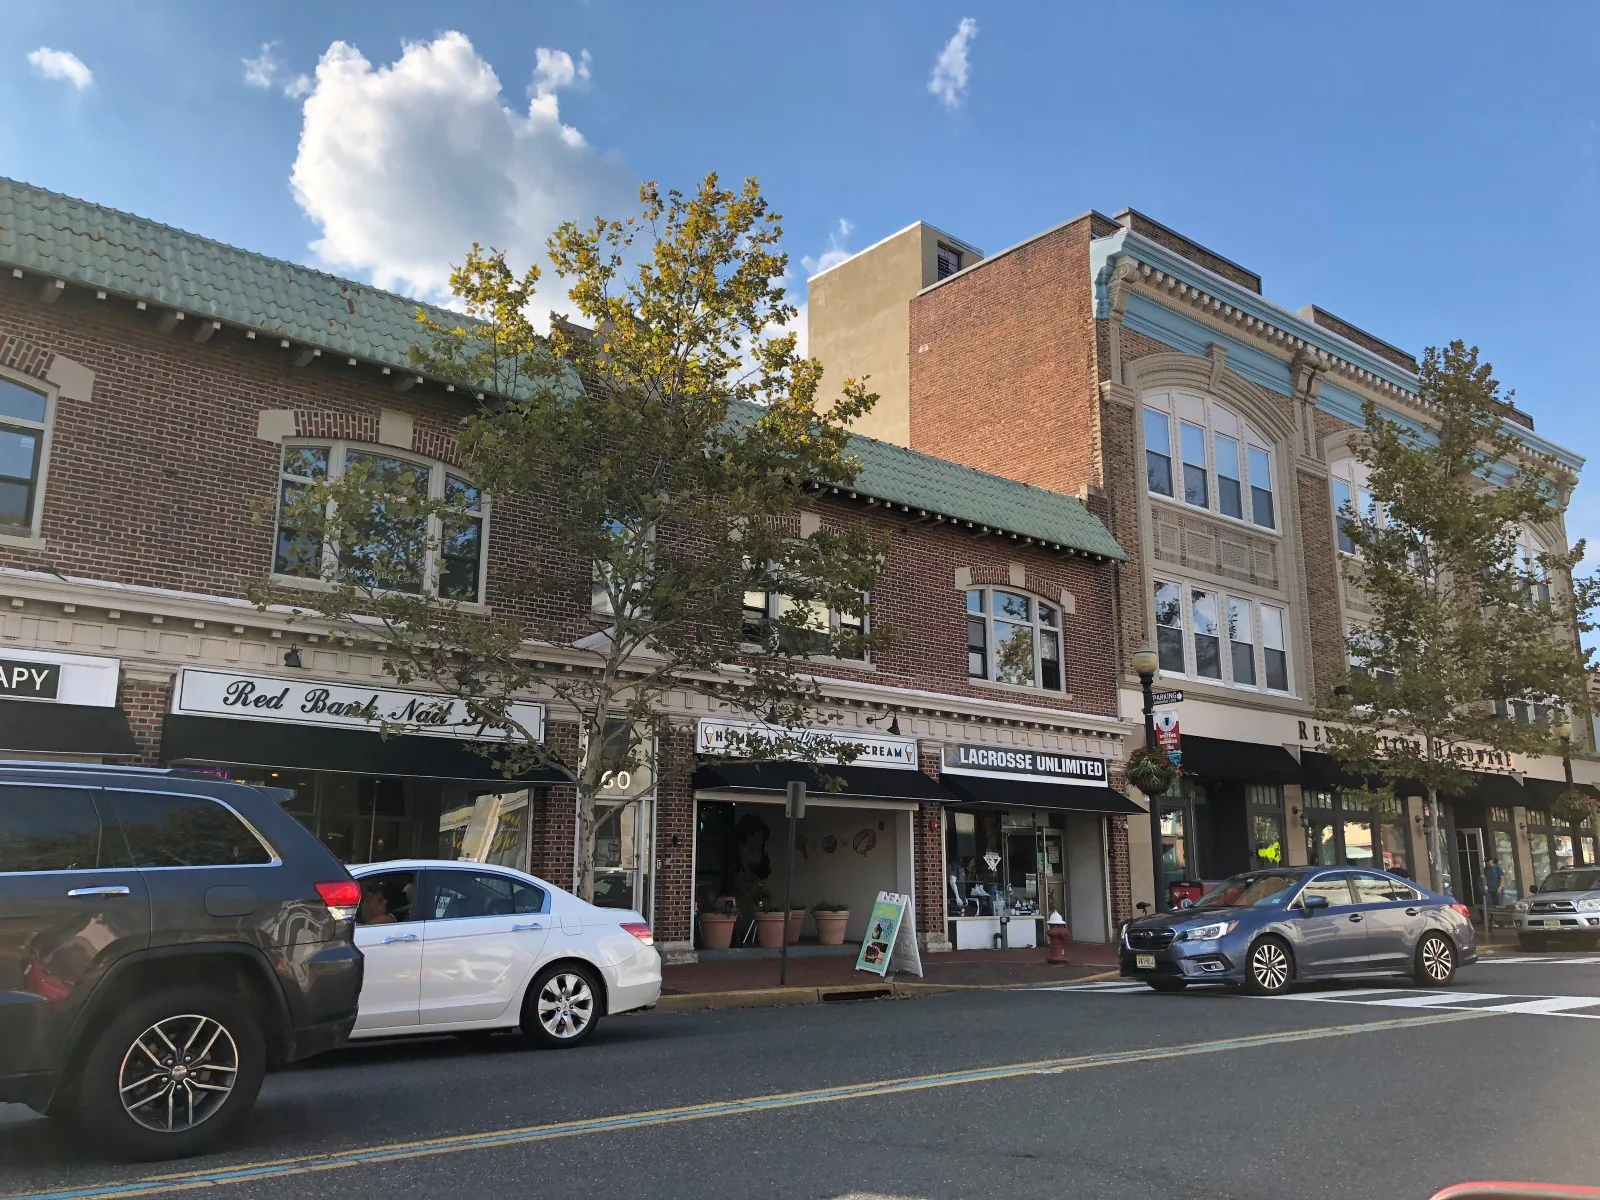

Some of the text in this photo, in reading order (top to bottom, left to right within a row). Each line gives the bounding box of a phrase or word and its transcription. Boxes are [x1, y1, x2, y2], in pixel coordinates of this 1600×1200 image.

[222, 679, 291, 710] Red
[299, 687, 383, 721] Bank
[388, 697, 455, 725] Nail
[1152, 691, 1177, 701] PARKING
[863, 744, 903, 758] CREAM
[959, 747, 1103, 777] LACROSSE UNLIMITED
[600, 769, 631, 790] 60
